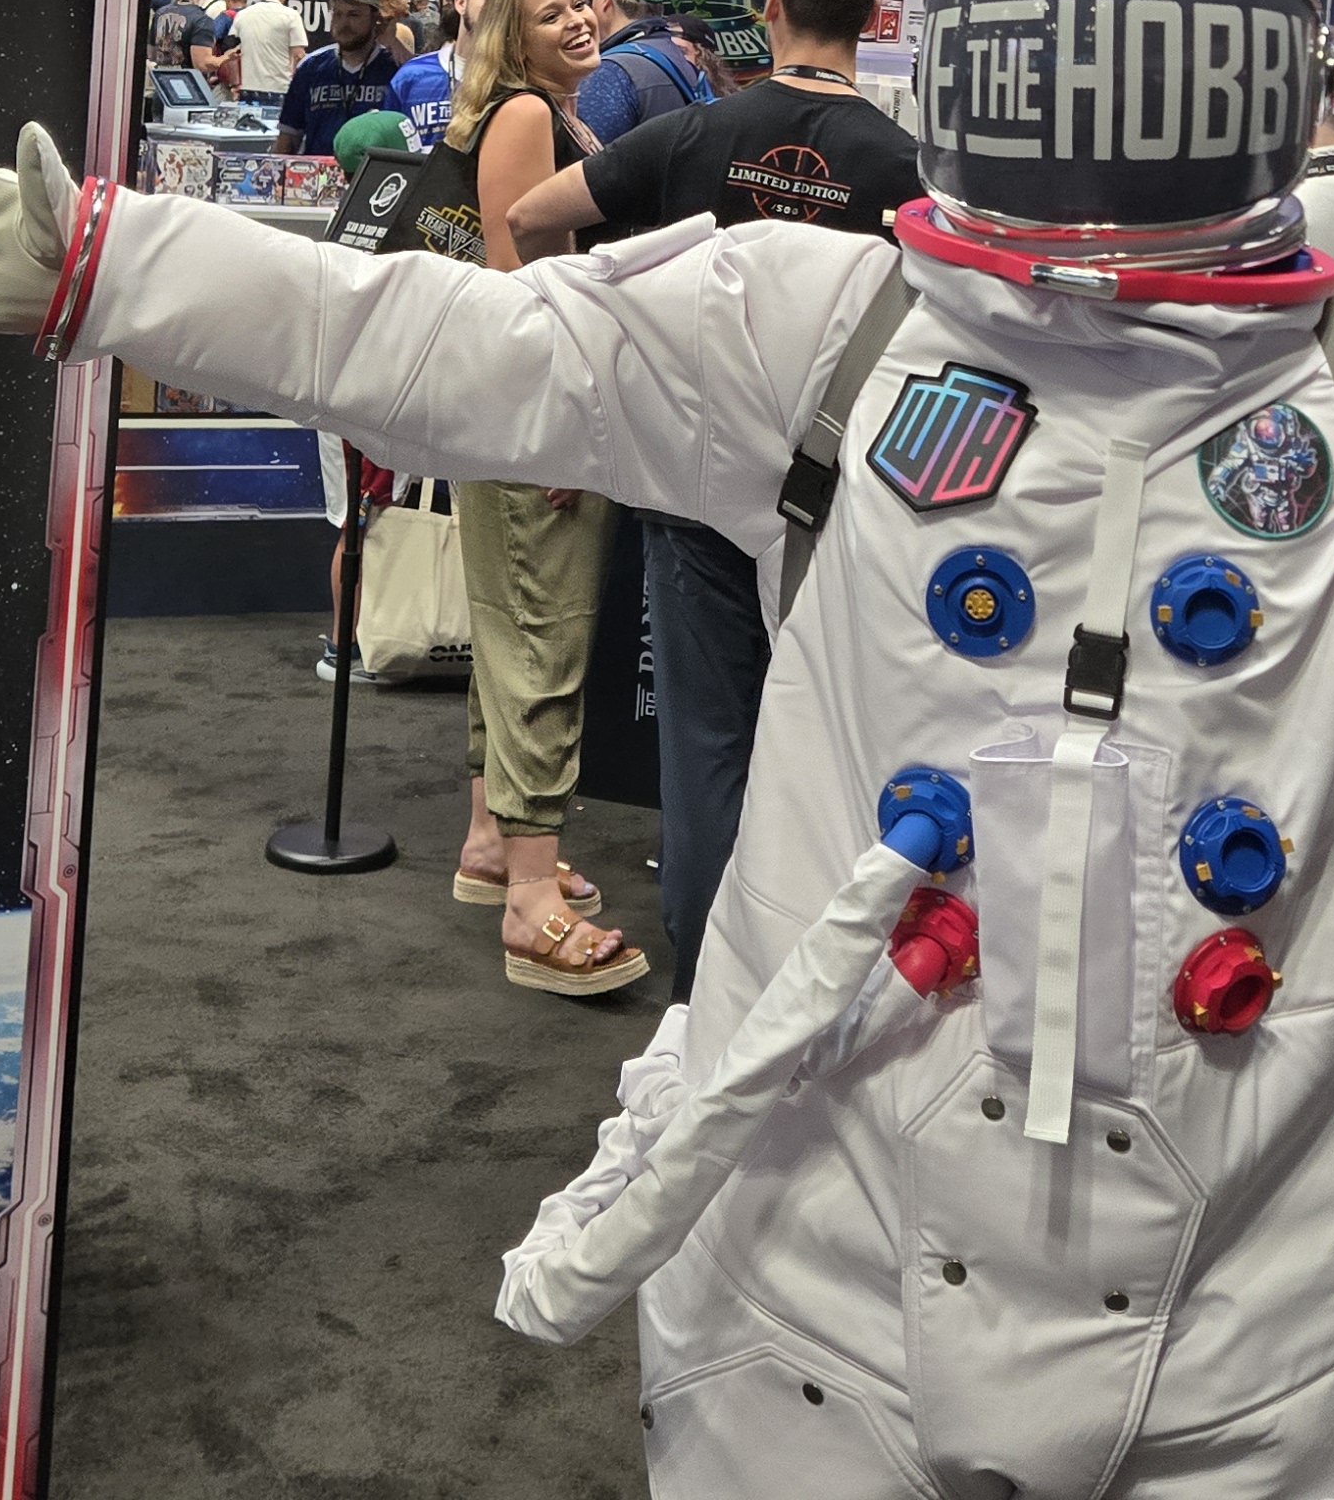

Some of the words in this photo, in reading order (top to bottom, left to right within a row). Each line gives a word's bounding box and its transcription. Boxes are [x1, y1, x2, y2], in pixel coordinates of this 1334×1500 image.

[918, 6, 963, 152] E
[967, 37, 1044, 122] THE
[309, 85, 329, 104] WE
[411, 102, 438, 127] WE
[728, 166, 791, 191] LIMITED
[792, 181, 851, 204] EDITION
[424, 213, 450, 236] YEARS
